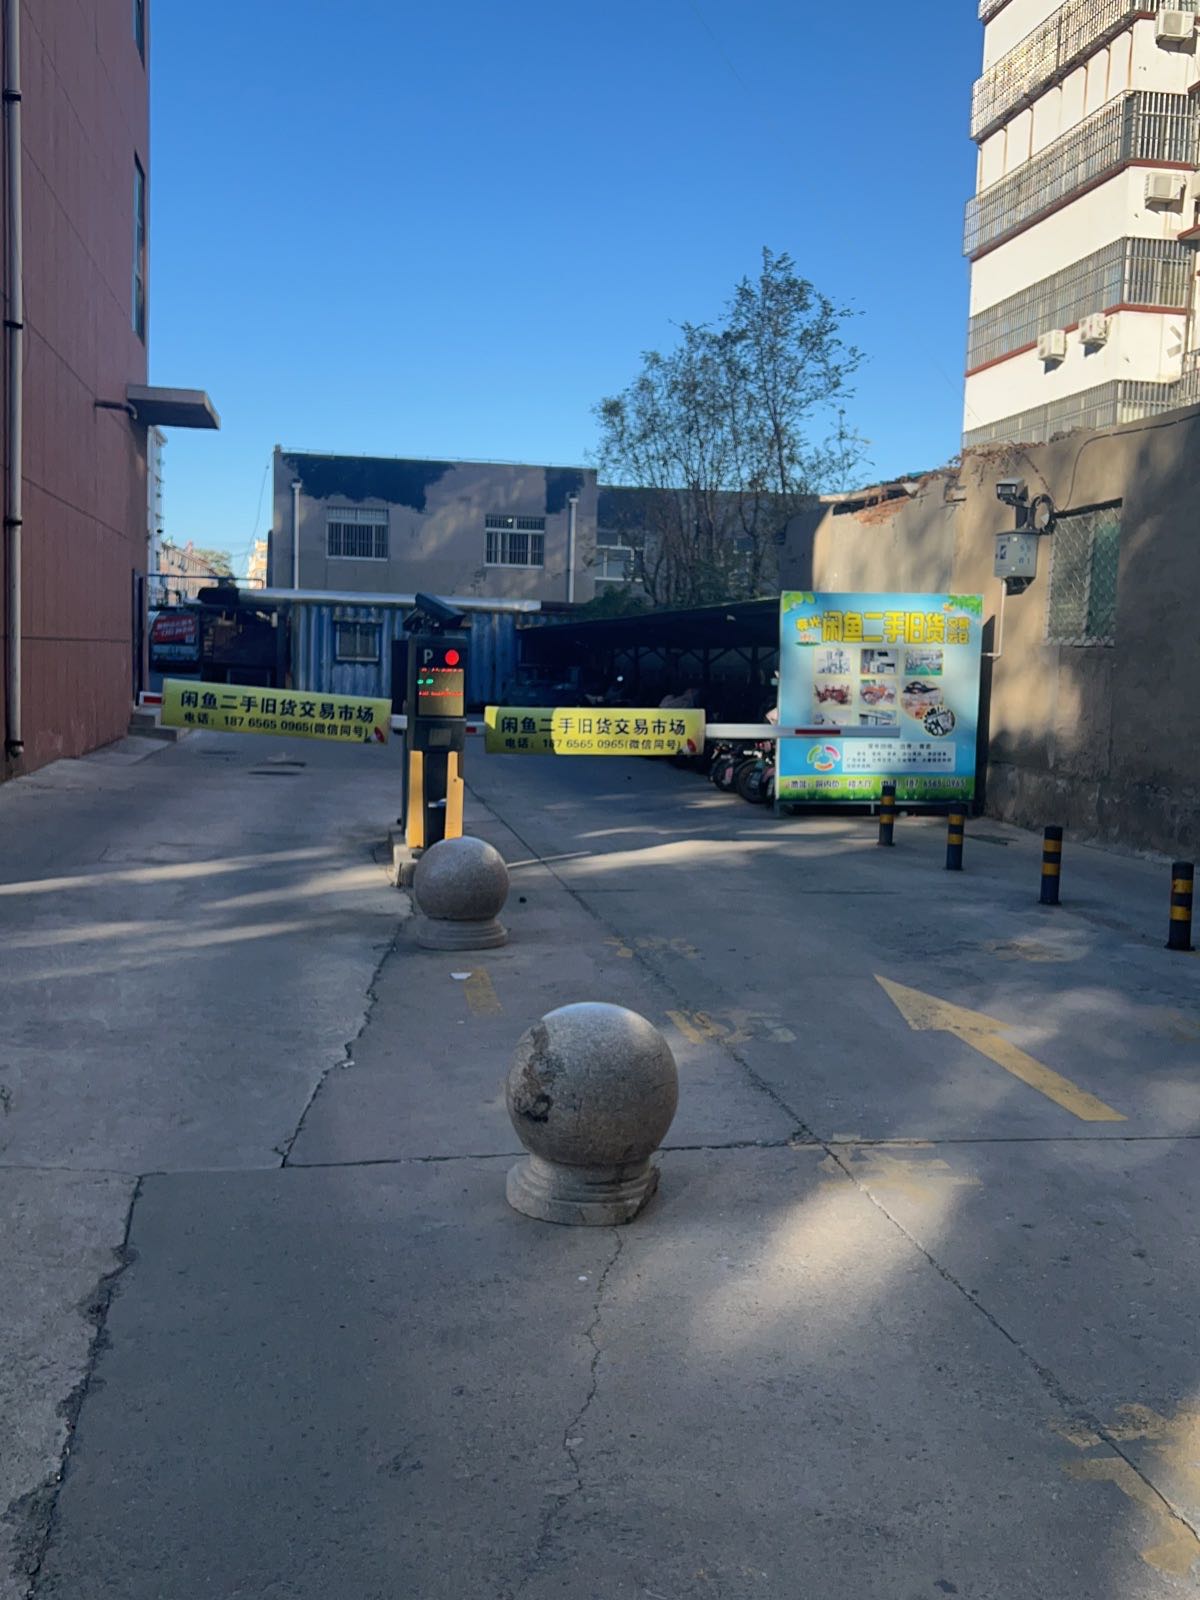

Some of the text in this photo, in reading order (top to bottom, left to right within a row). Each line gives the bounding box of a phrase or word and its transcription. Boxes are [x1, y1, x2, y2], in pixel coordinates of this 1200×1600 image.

[821, 610, 945, 644] 闲鱼二手旧货
[423, 648, 434, 664] P
[180, 690, 374, 724] 闲鱼二手旧货交易市场
[224, 716, 244, 727] 187
[248, 717, 277, 729] 6565
[501, 716, 686, 736] 闲鱼二手旧货交易市场
[543, 738, 562, 749] 187
[566, 739, 593, 749] 6565
